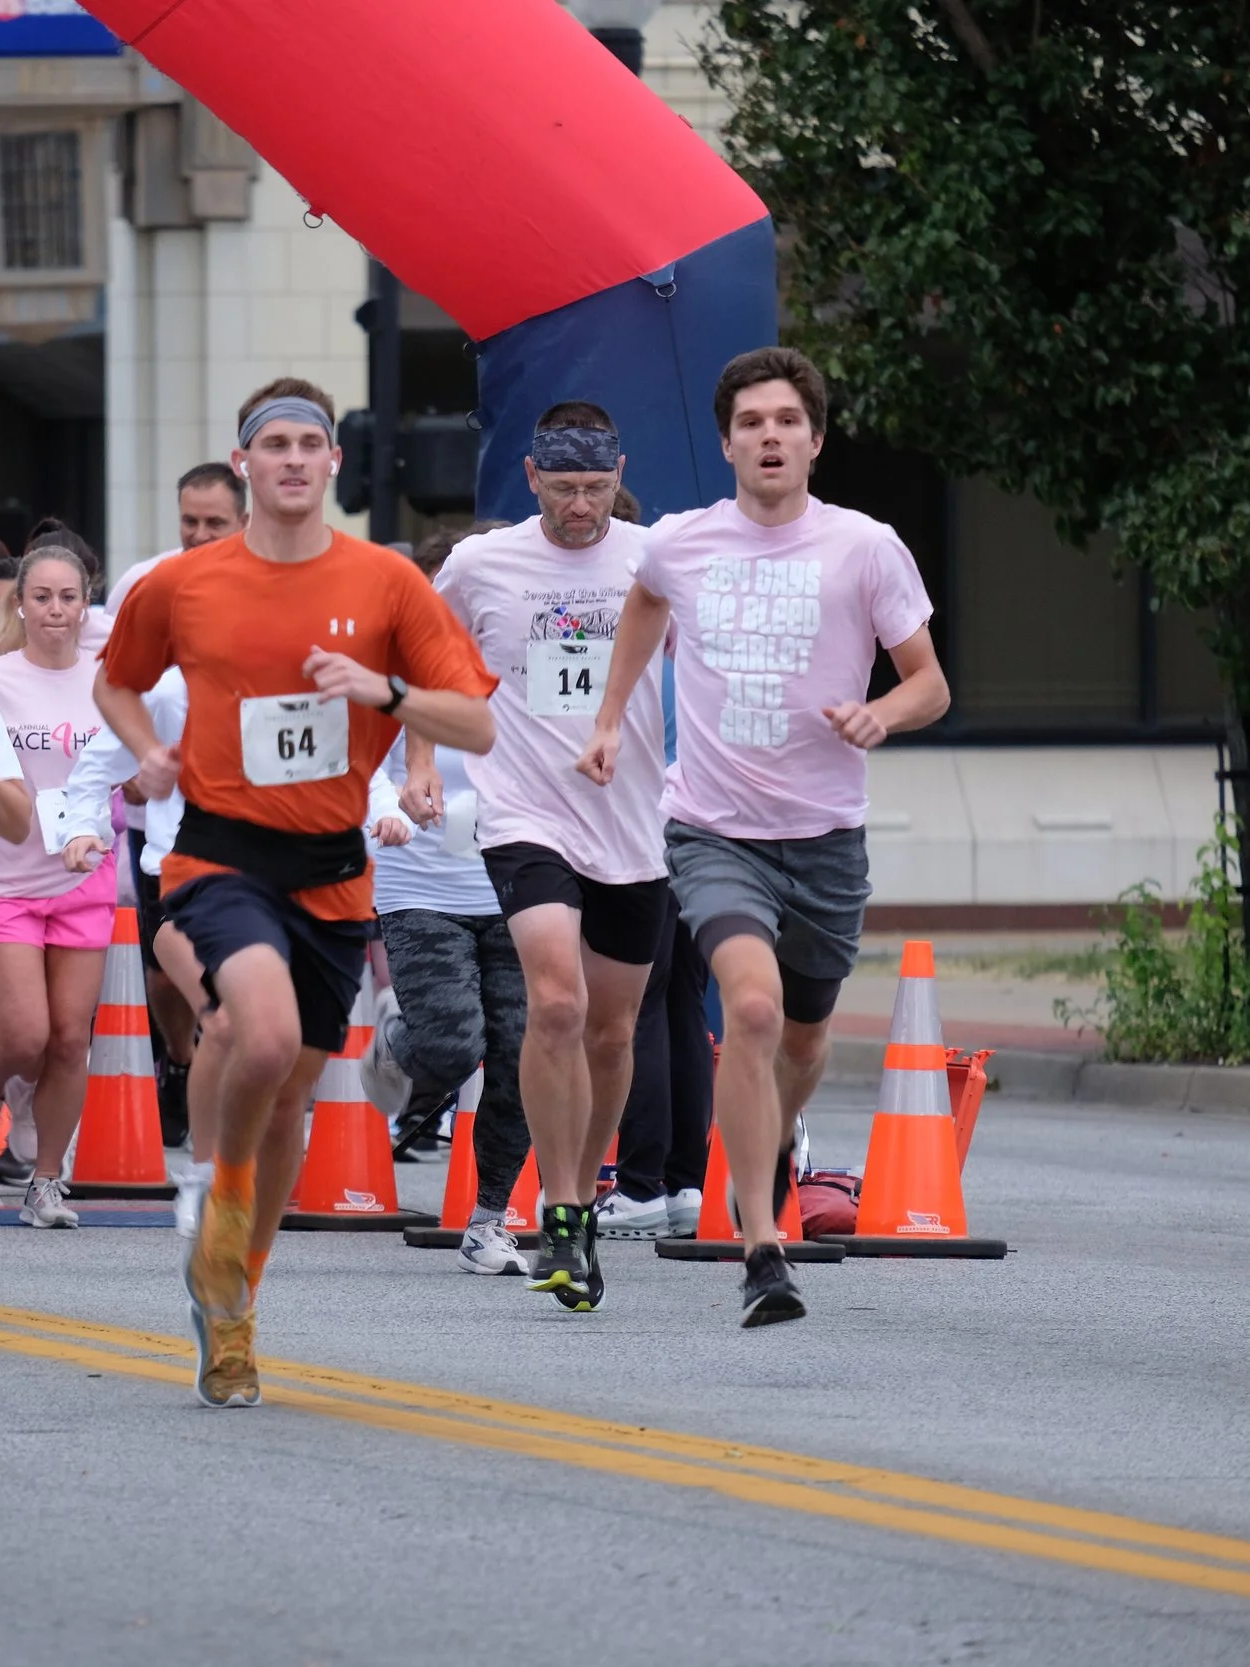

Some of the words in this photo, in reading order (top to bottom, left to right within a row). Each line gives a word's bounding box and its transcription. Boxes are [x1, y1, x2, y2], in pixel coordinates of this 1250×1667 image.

[702, 555, 751, 594] 364
[755, 558, 822, 596] DAYS
[701, 632, 814, 675] SCARLET
[558, 667, 592, 696] 14
[726, 672, 783, 709] AND
[8, 732, 51, 750] ACE
[277, 725, 318, 760] 64
[720, 708, 789, 747] GRAY
